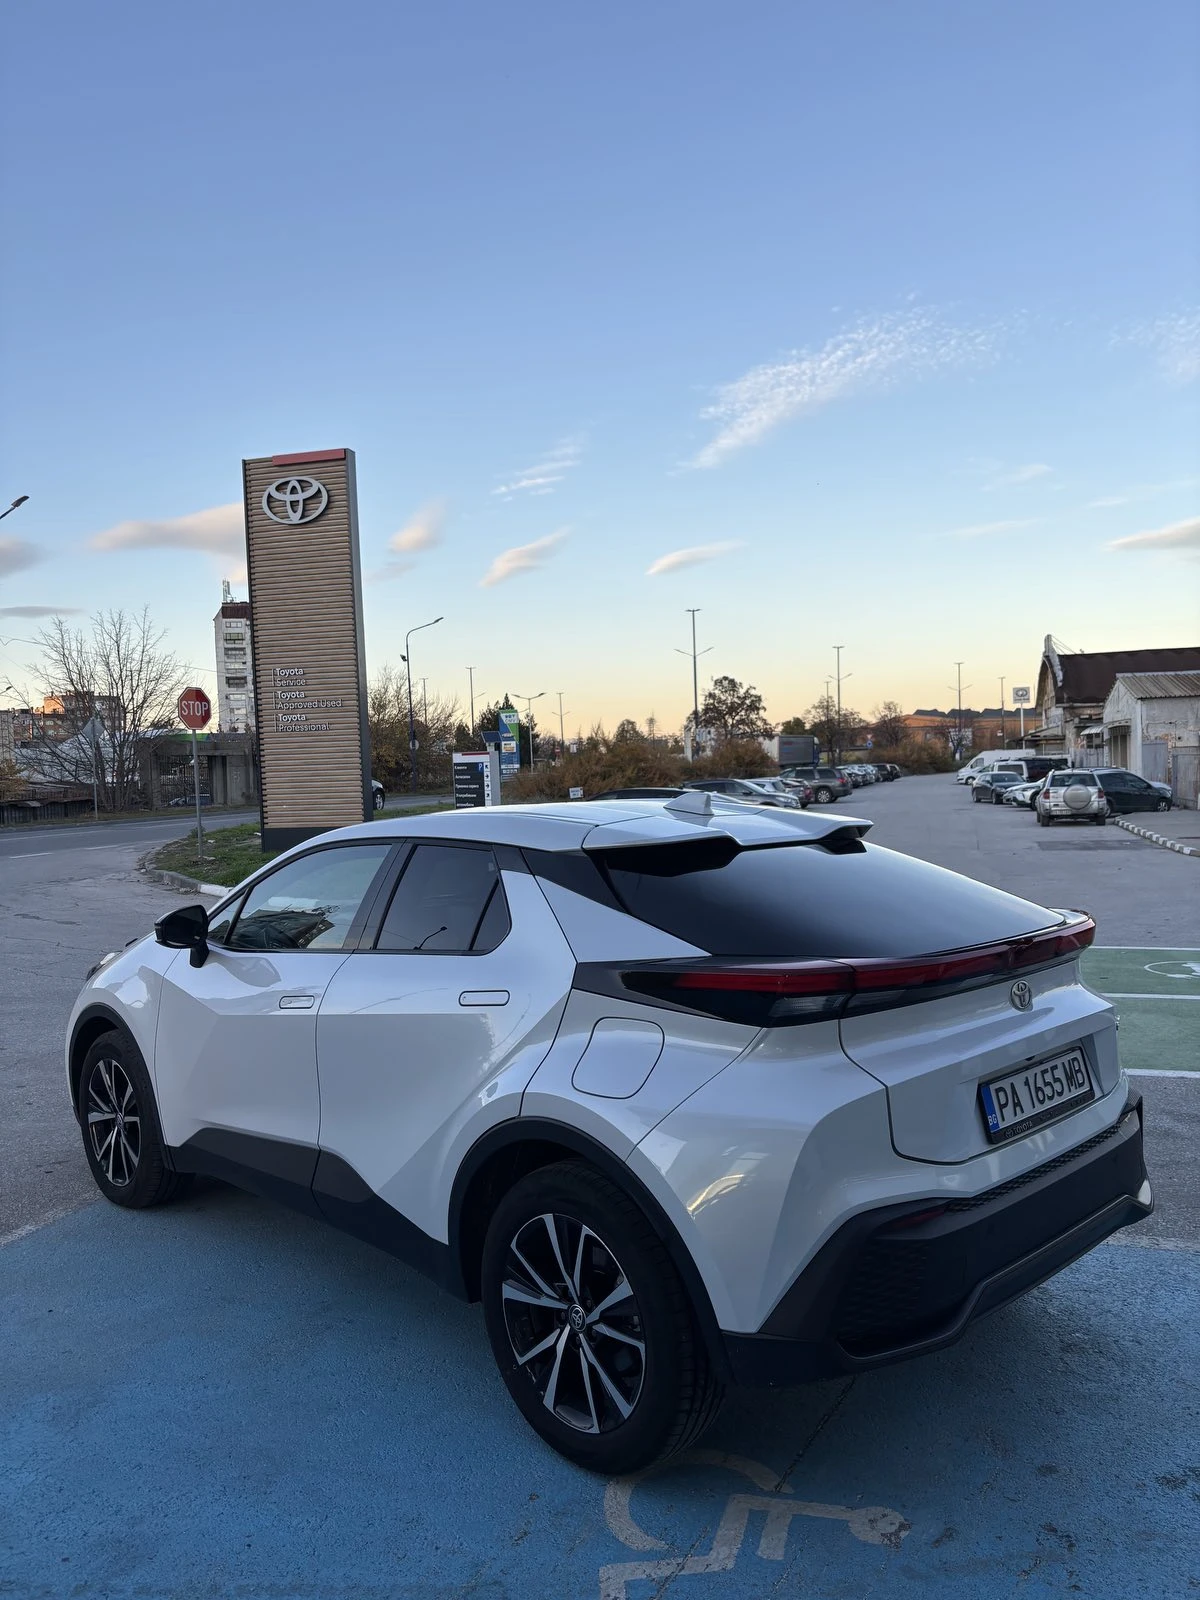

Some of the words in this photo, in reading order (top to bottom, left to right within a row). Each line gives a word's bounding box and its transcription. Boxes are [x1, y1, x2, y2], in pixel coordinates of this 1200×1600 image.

[275, 667, 304, 678] Toyota
[275, 677, 306, 687] Service
[276, 690, 305, 701] Toyota
[181, 700, 209, 717] STOP
[277, 700, 318, 710] Approved
[320, 698, 342, 708] Used
[277, 713, 306, 723] Toyota
[278, 722, 330, 733] Professional
[994, 1082, 1025, 1122] PA
[1023, 1064, 1065, 1109] 1655
[1061, 1056, 1086, 1093] MB
[988, 1114, 998, 1126] BG
